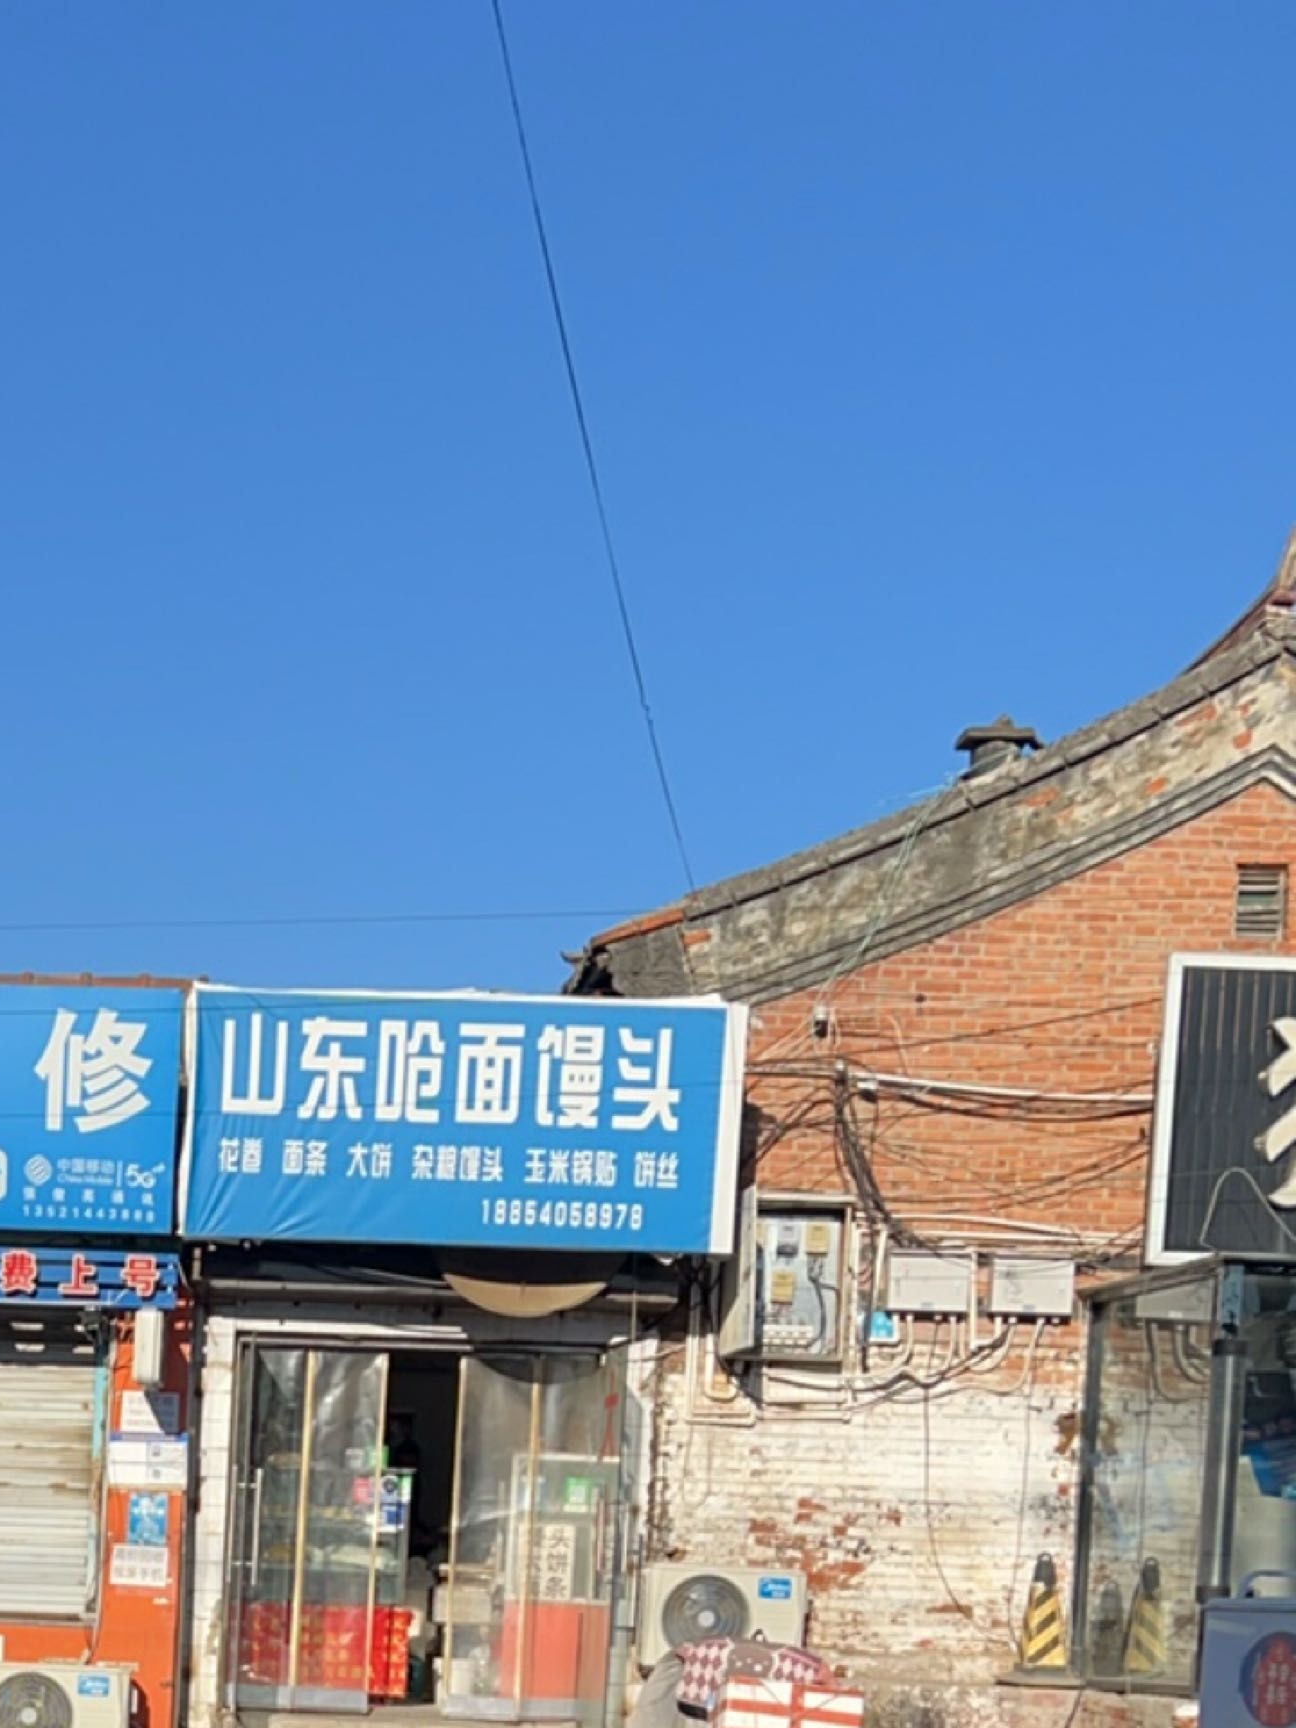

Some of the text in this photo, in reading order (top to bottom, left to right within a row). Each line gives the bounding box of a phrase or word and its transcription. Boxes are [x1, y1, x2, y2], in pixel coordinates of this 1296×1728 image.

[221, 1012, 681, 1131] 山东呛面馒头
[282, 1139, 329, 1177] 面条
[346, 1141, 393, 1180] 大饼
